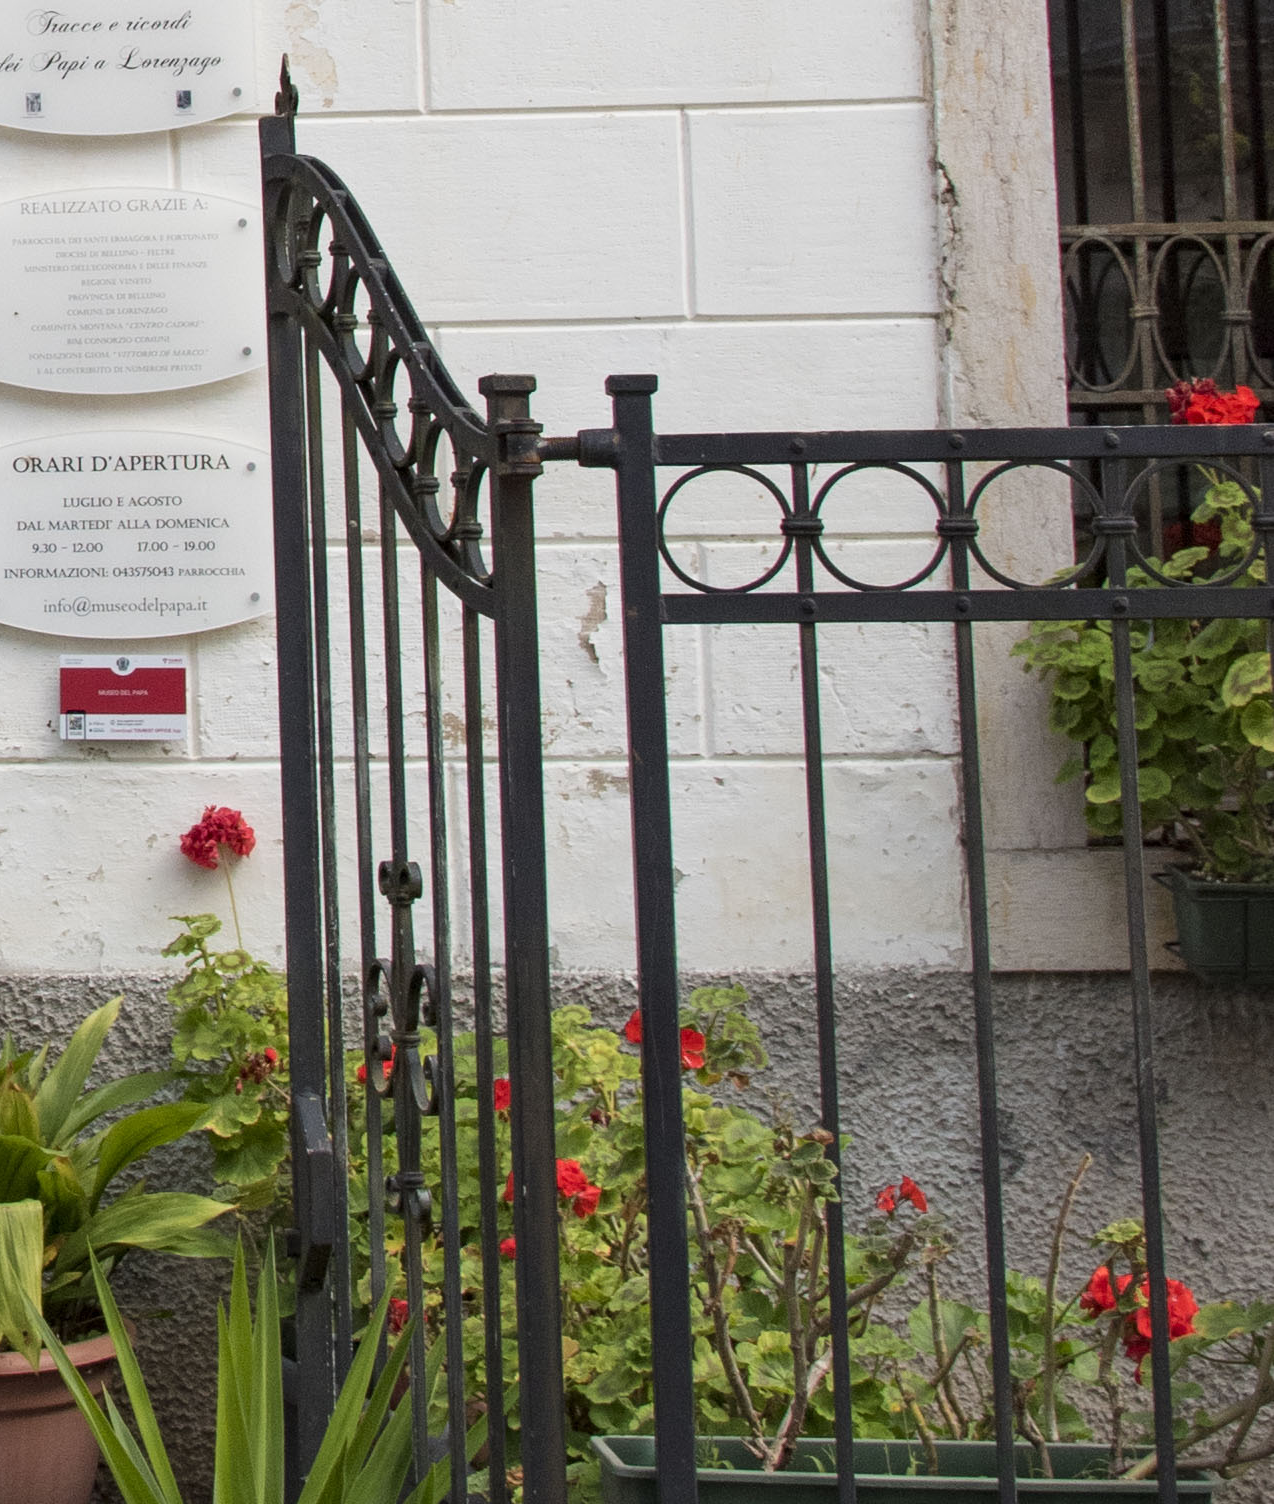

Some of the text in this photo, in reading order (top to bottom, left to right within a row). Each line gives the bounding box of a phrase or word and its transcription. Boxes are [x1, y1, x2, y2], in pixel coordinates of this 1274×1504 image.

[26, 8, 192, 36] Tracce e ricordi
[29, 51, 89, 79] Papi
[94, 59, 107, 70] a
[116, 47, 223, 77] Lorenzago
[21, 198, 209, 215] REALIZZATO GRAZIE A:
[12, 236, 66, 246] PARROCCHIA
[84, 235, 109, 244] SANTI
[110, 234, 157, 243] ERMAGORA
[166, 233, 219, 241] FORTUNATO
[56, 250, 87, 258] DIOCESI
[101, 249, 139, 257] BELLUNO
[147, 248, 175, 256] FELTRE
[24, 264, 68, 272] MINISTERO
[146, 262, 170, 270] DELLE
[172, 261, 208, 269] FINANZE
[81, 277, 151, 286] REGIONE VENETO
[68, 292, 165, 301] PROVINCIA DI BELLUNO
[67, 306, 168, 316] COMUNE DI LORENZAGO
[80, 322, 124, 330] MONTANA
[84, 336, 133, 344] CONSORZIO
[29, 352, 82, 360] FONDAZIONE
[56, 366, 112, 374] CONTRIBUTO
[114, 365, 124, 373] DI
[125, 364, 169, 373] NUMEROSI
[171, 364, 202, 372] PRIVATI
[12, 454, 230, 473] ORARI D'APERTURA
[63, 496, 182, 508] LUGLIO E AGOSTO
[17, 520, 44, 531] DAL
[118, 519, 151, 529] ALLA
[156, 518, 229, 529] DOMENICA
[32, 543, 57, 553] 9.30
[72, 542, 103, 553] 12.00
[137, 541, 168, 552] 17.00
[184, 540, 215, 551] 19.00
[4, 566, 245, 579] INFORMAZIONI: 043575043 PARROCCHIA
[44, 595, 208, 617] info@museodelpapa.it
